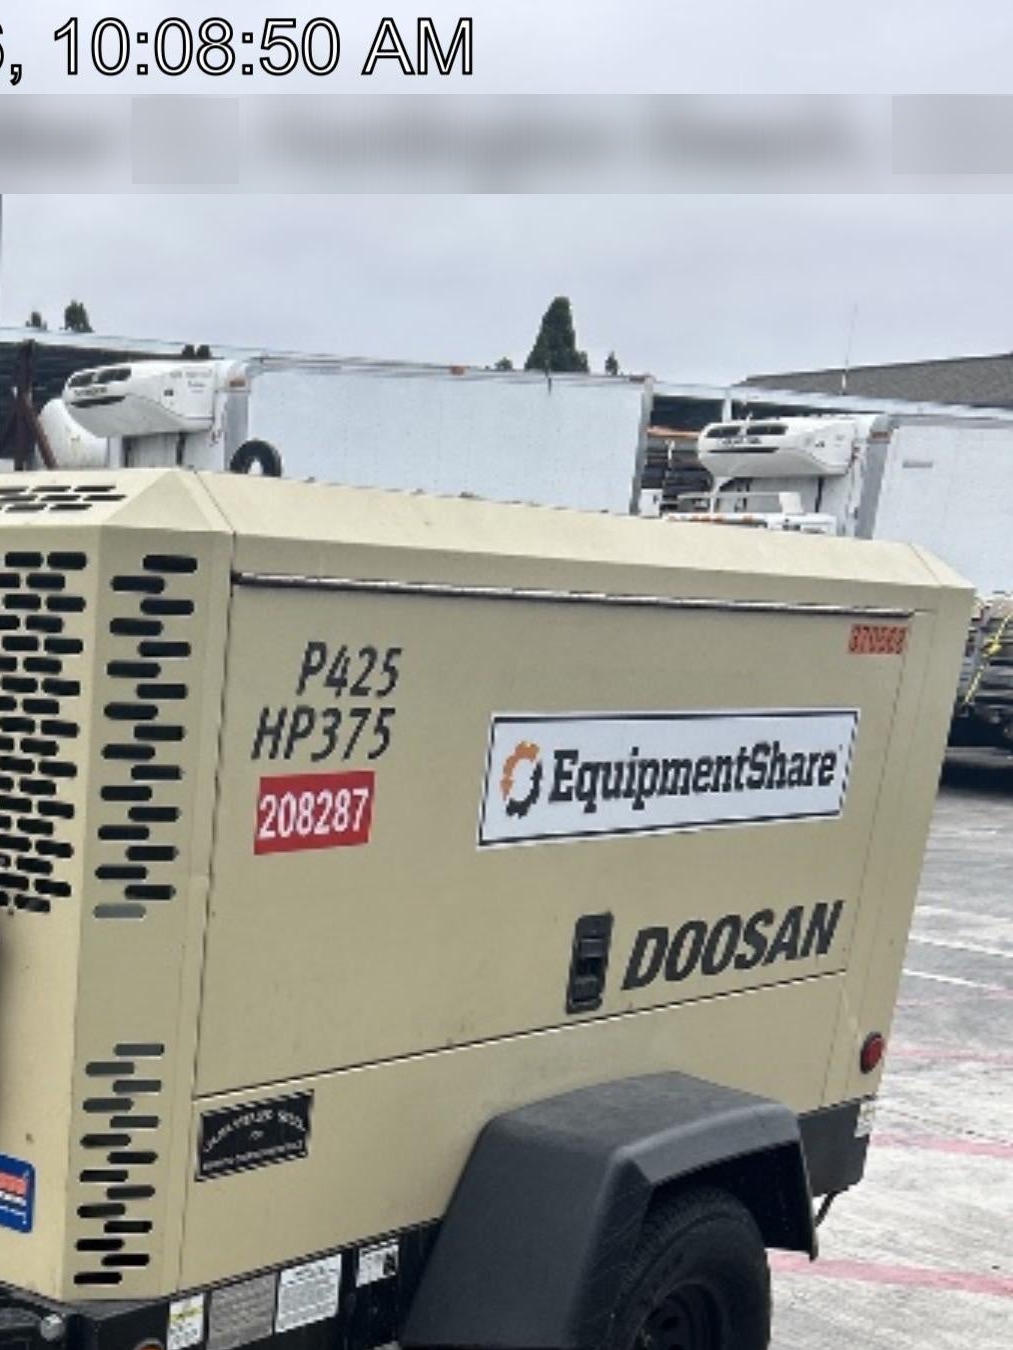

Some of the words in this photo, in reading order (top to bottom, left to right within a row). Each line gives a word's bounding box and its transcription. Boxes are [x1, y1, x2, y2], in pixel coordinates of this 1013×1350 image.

[296, 641, 403, 697] P425
[250, 704, 396, 761] HP375
[548, 740, 838, 813] EquipmentShare
[258, 788, 369, 839] 208287
[620, 900, 844, 991] DOOSAN
